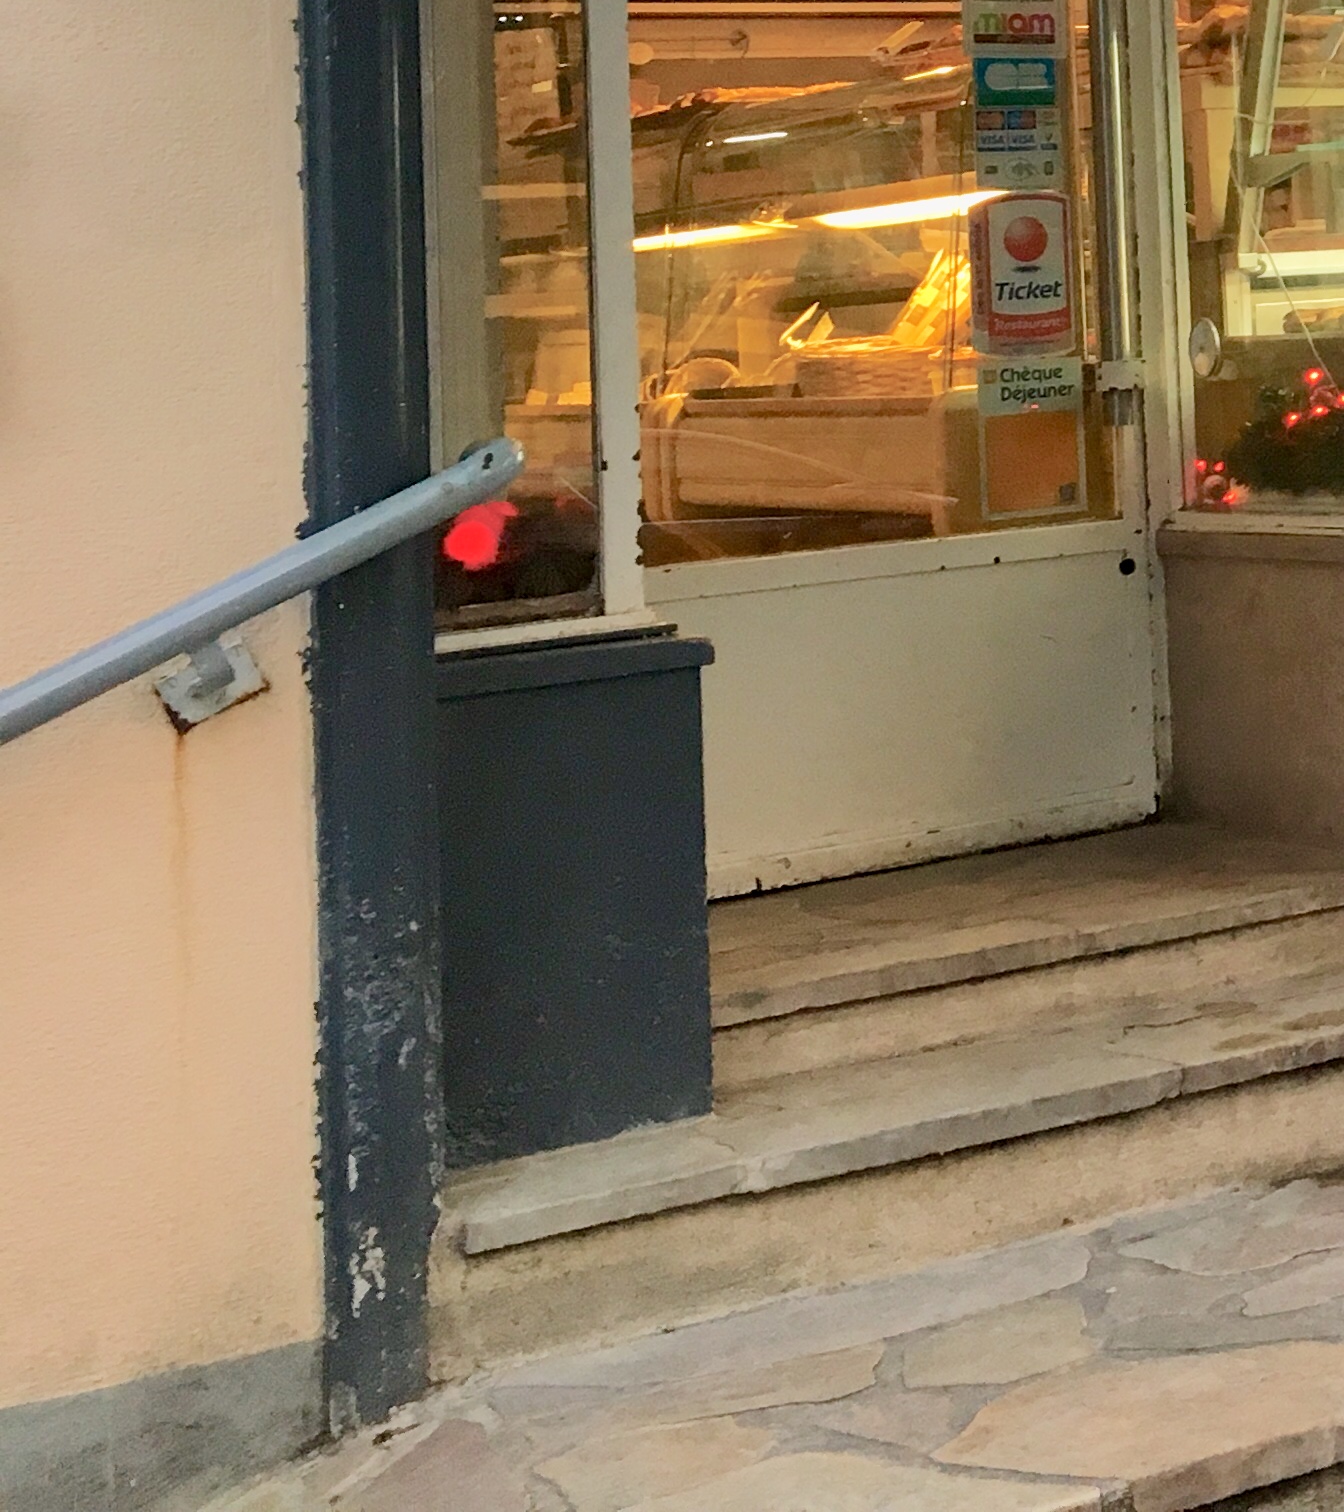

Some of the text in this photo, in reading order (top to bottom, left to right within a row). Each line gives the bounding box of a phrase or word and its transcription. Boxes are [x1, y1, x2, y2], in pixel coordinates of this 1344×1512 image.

[995, 279, 1064, 303] Ticket
[999, 365, 1064, 386] Chèque
[1000, 383, 1075, 404] Déjeuner
